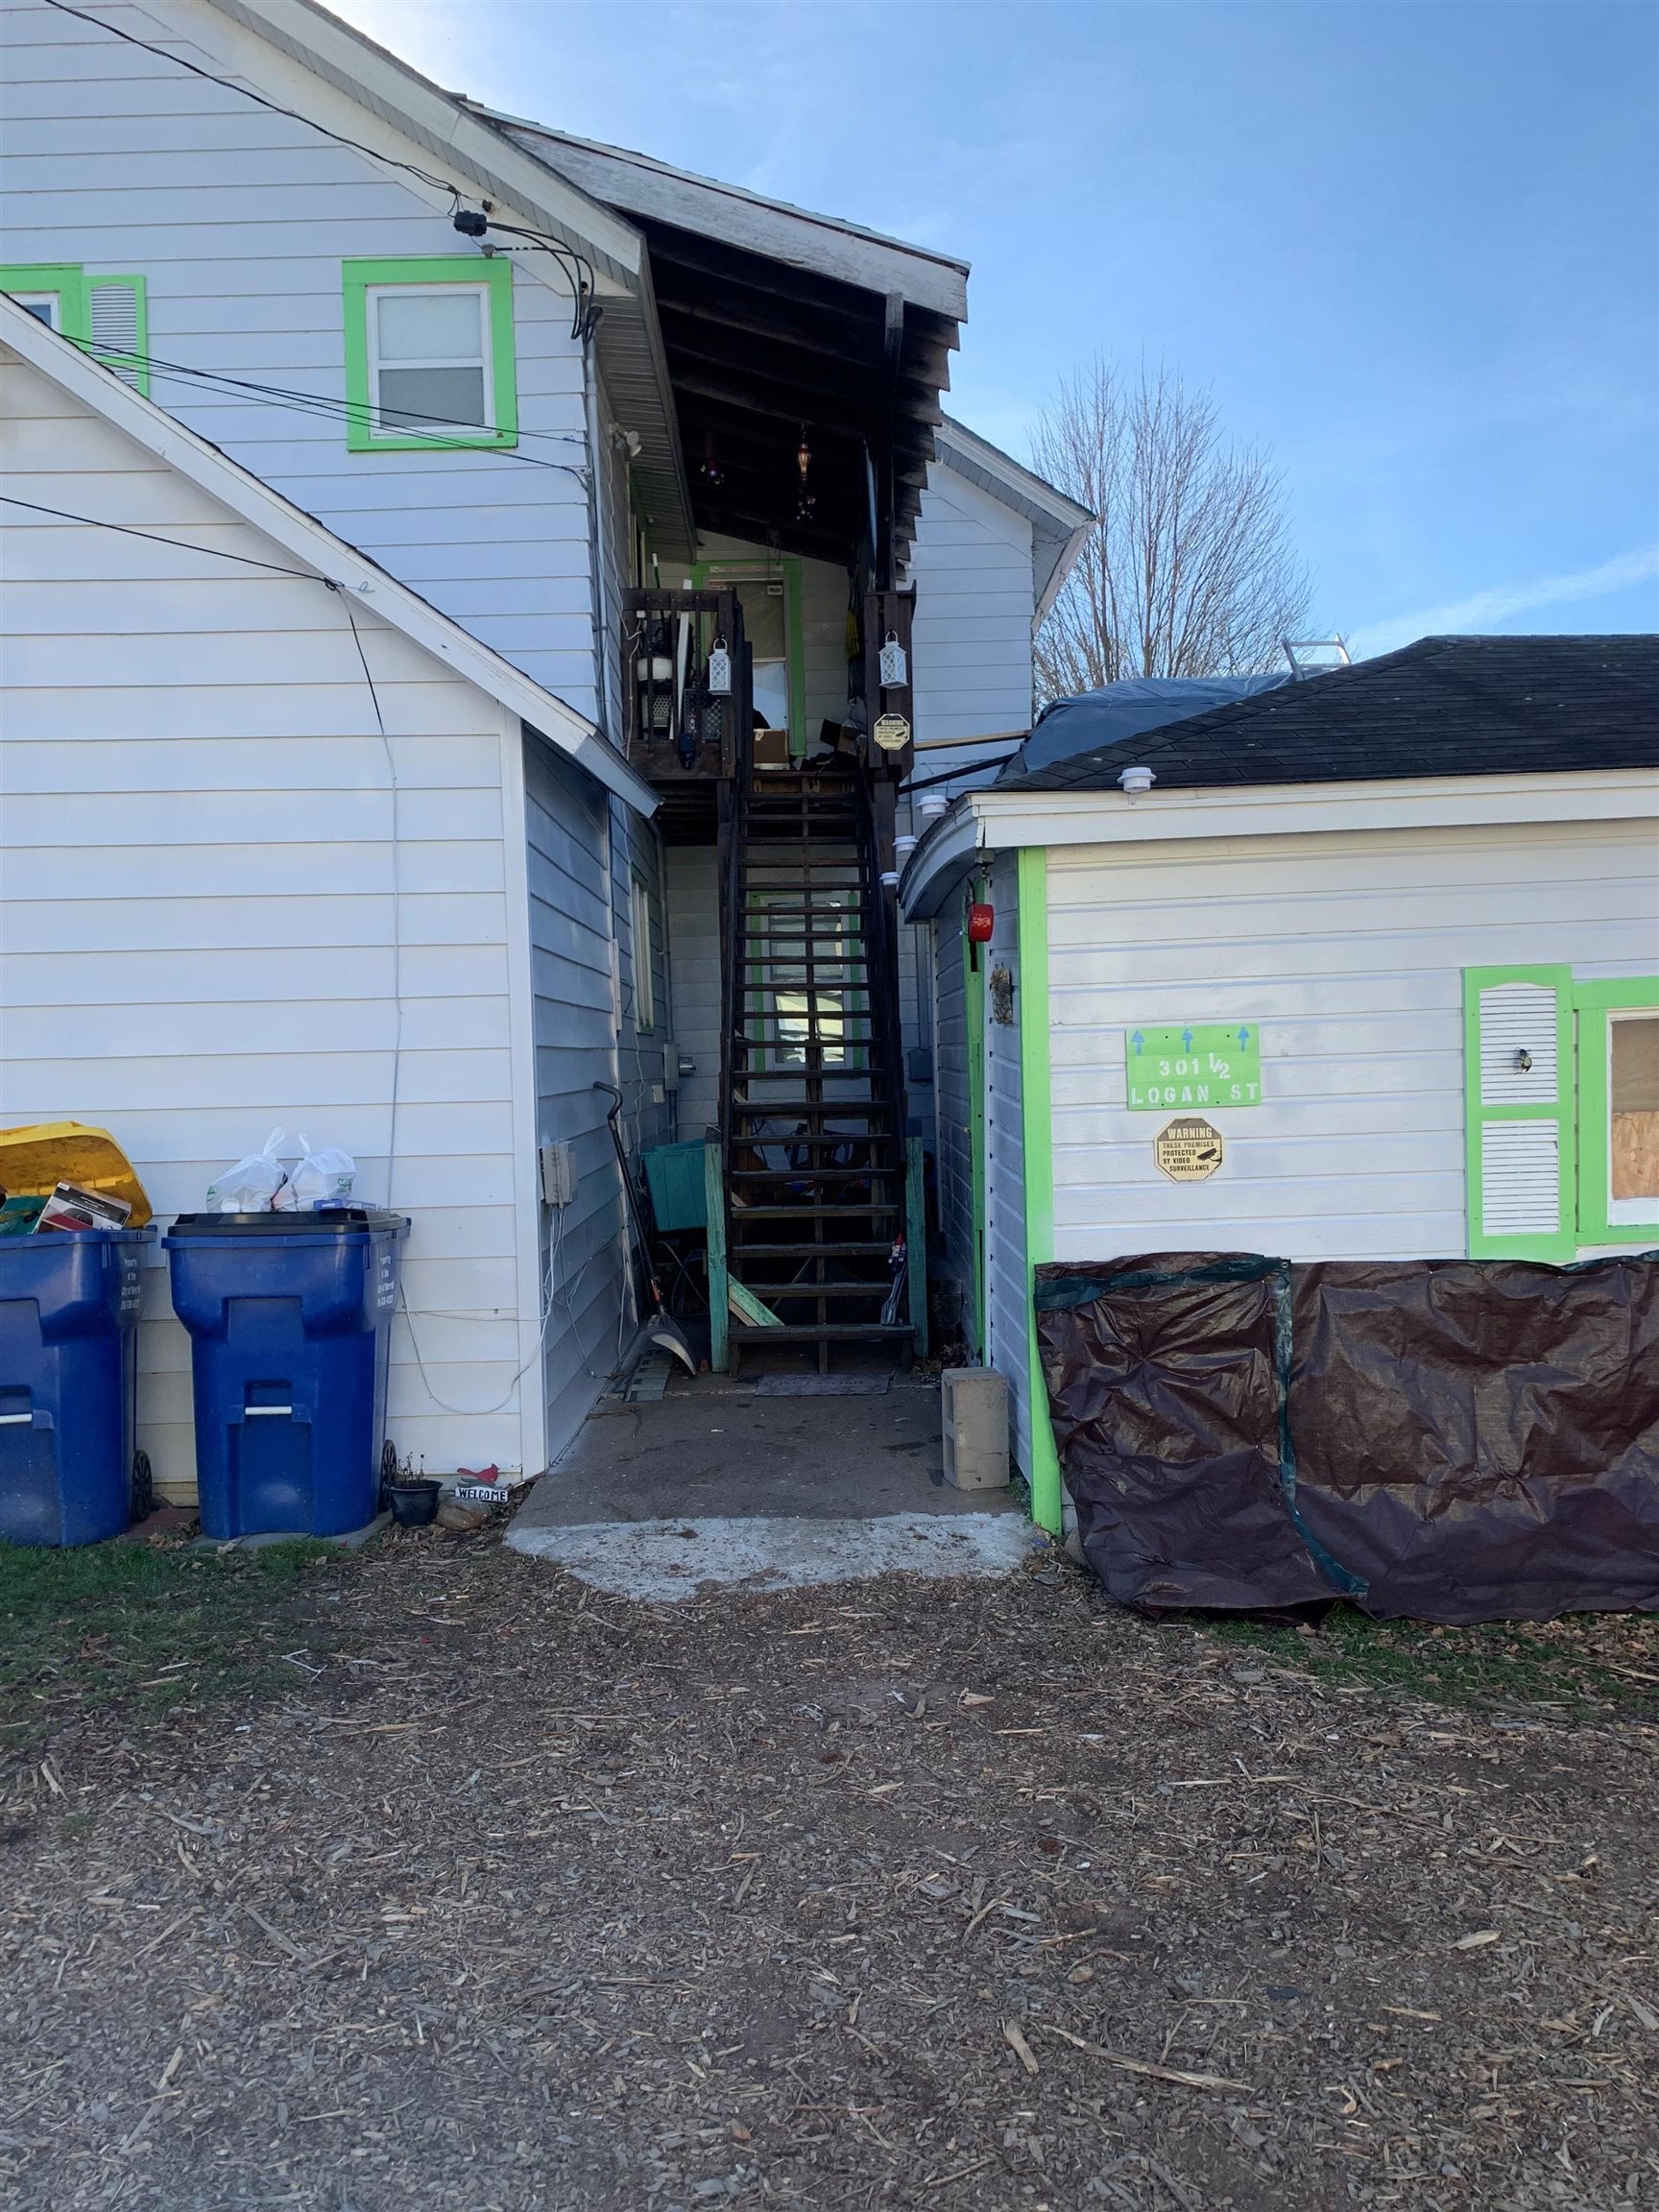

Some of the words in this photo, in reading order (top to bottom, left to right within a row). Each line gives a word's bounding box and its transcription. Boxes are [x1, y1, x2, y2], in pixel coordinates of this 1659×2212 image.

[1159, 1058, 1199, 1076] 301
[1131, 1085, 1210, 1105] LOGAN
[1229, 1083, 1259, 1100] ST
[1166, 1127, 1213, 1140] WARNING
[458, 1488, 506, 1502] WELCOME
